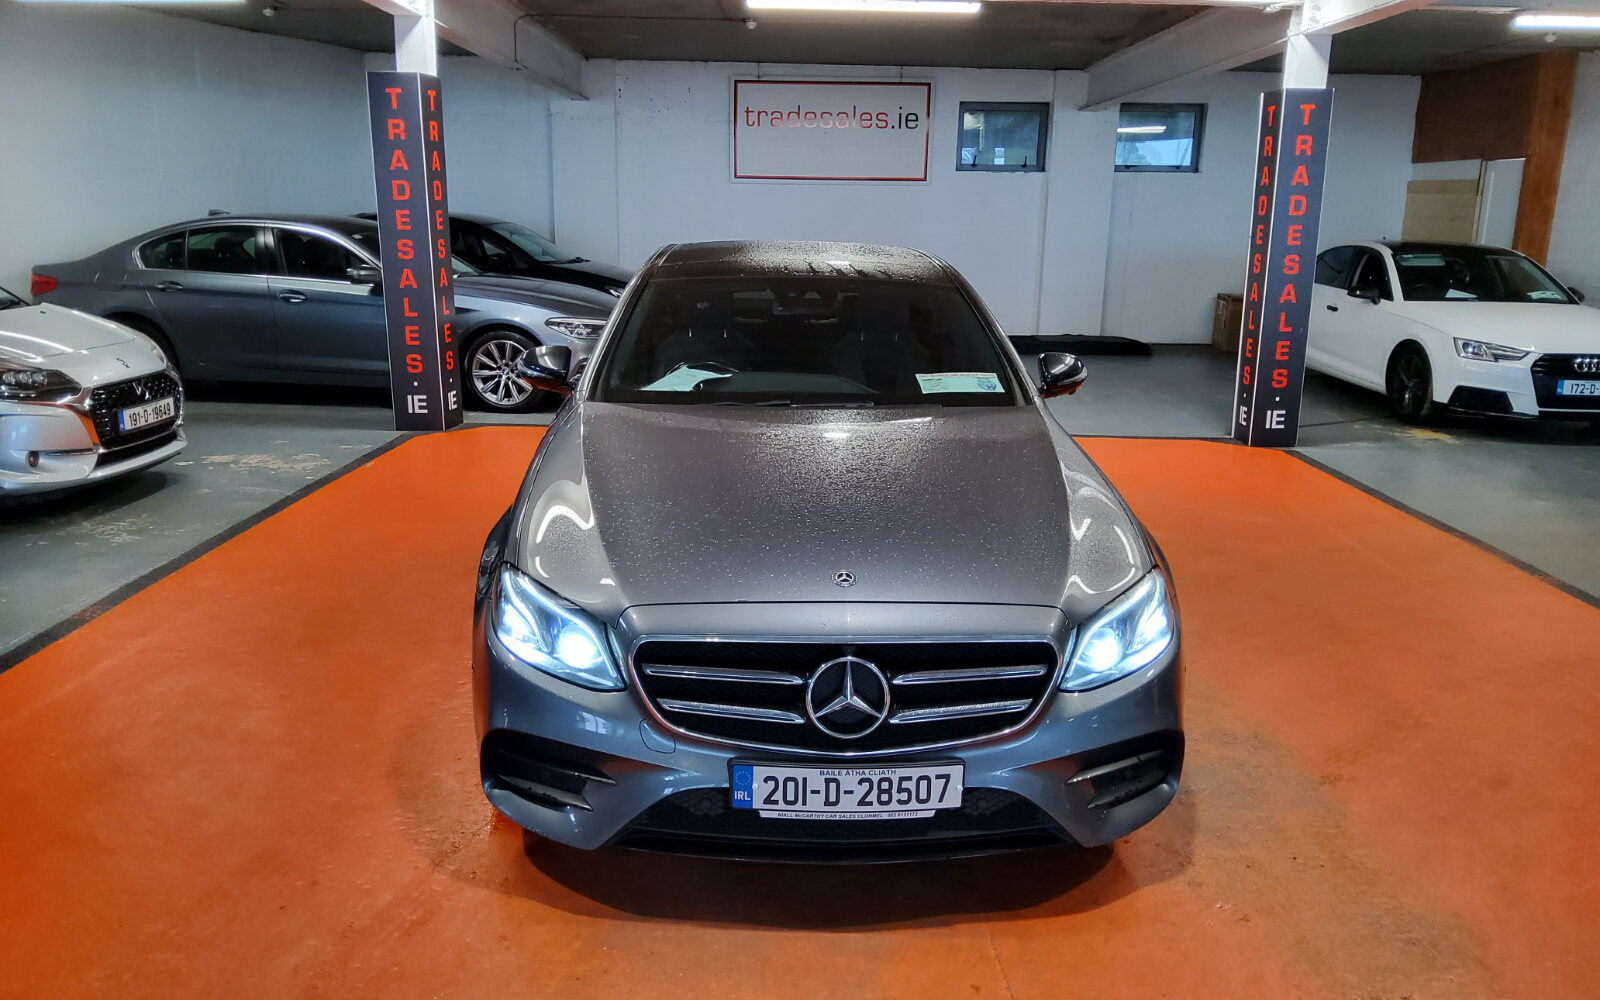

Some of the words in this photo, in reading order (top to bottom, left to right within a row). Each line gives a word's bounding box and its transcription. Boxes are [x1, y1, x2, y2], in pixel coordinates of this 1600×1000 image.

[744, 104, 919, 129] tradesales.ie
[734, 790, 752, 801] IRL
[763, 773, 951, 807] 201-D-28507
